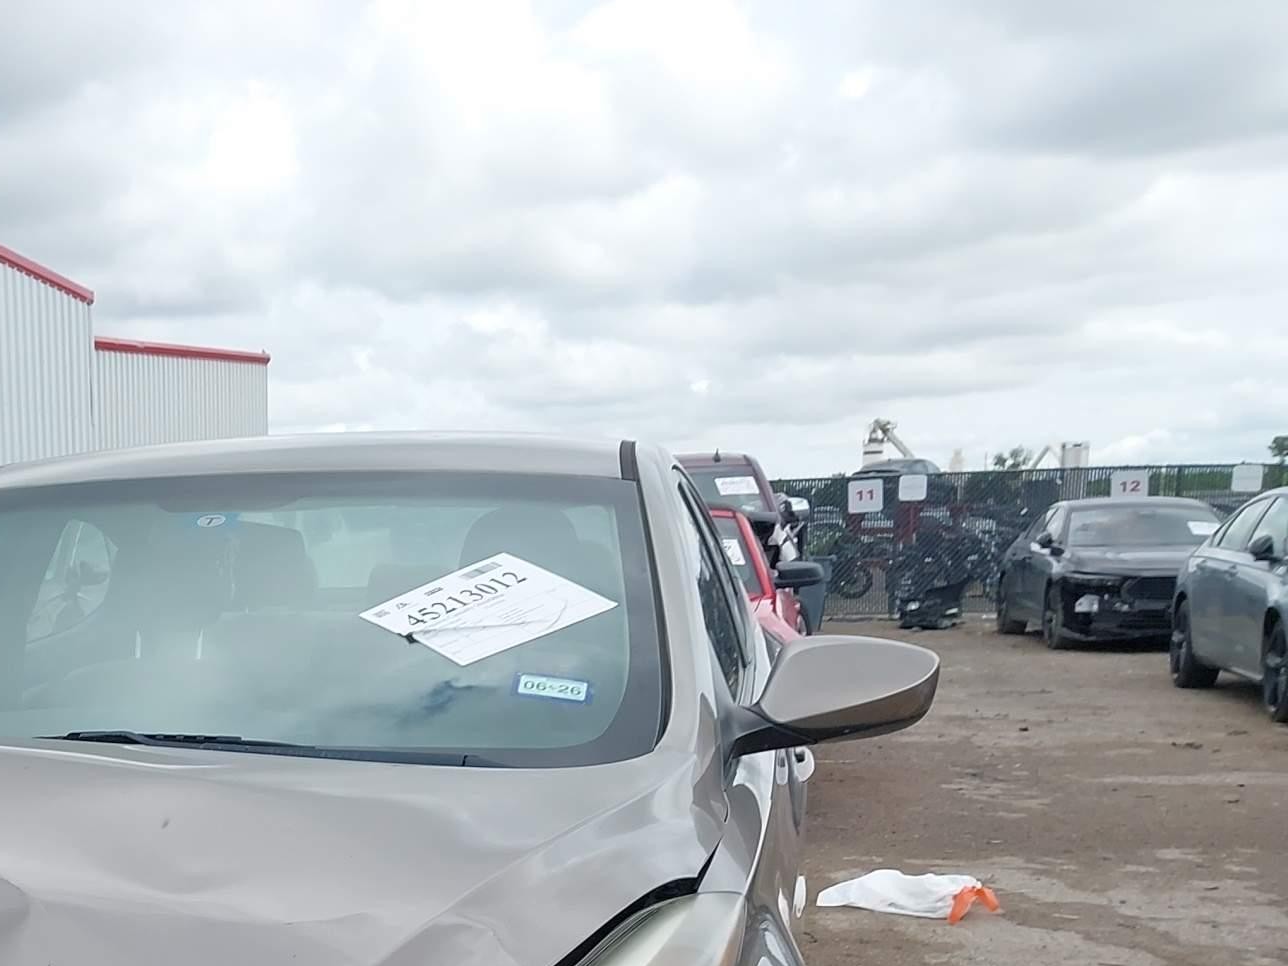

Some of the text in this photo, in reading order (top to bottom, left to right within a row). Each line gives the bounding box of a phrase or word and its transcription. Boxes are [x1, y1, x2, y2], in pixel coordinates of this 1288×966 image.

[1119, 479, 1141, 493] 12
[855, 488, 875, 502] 11
[407, 571, 528, 626] 45213012
